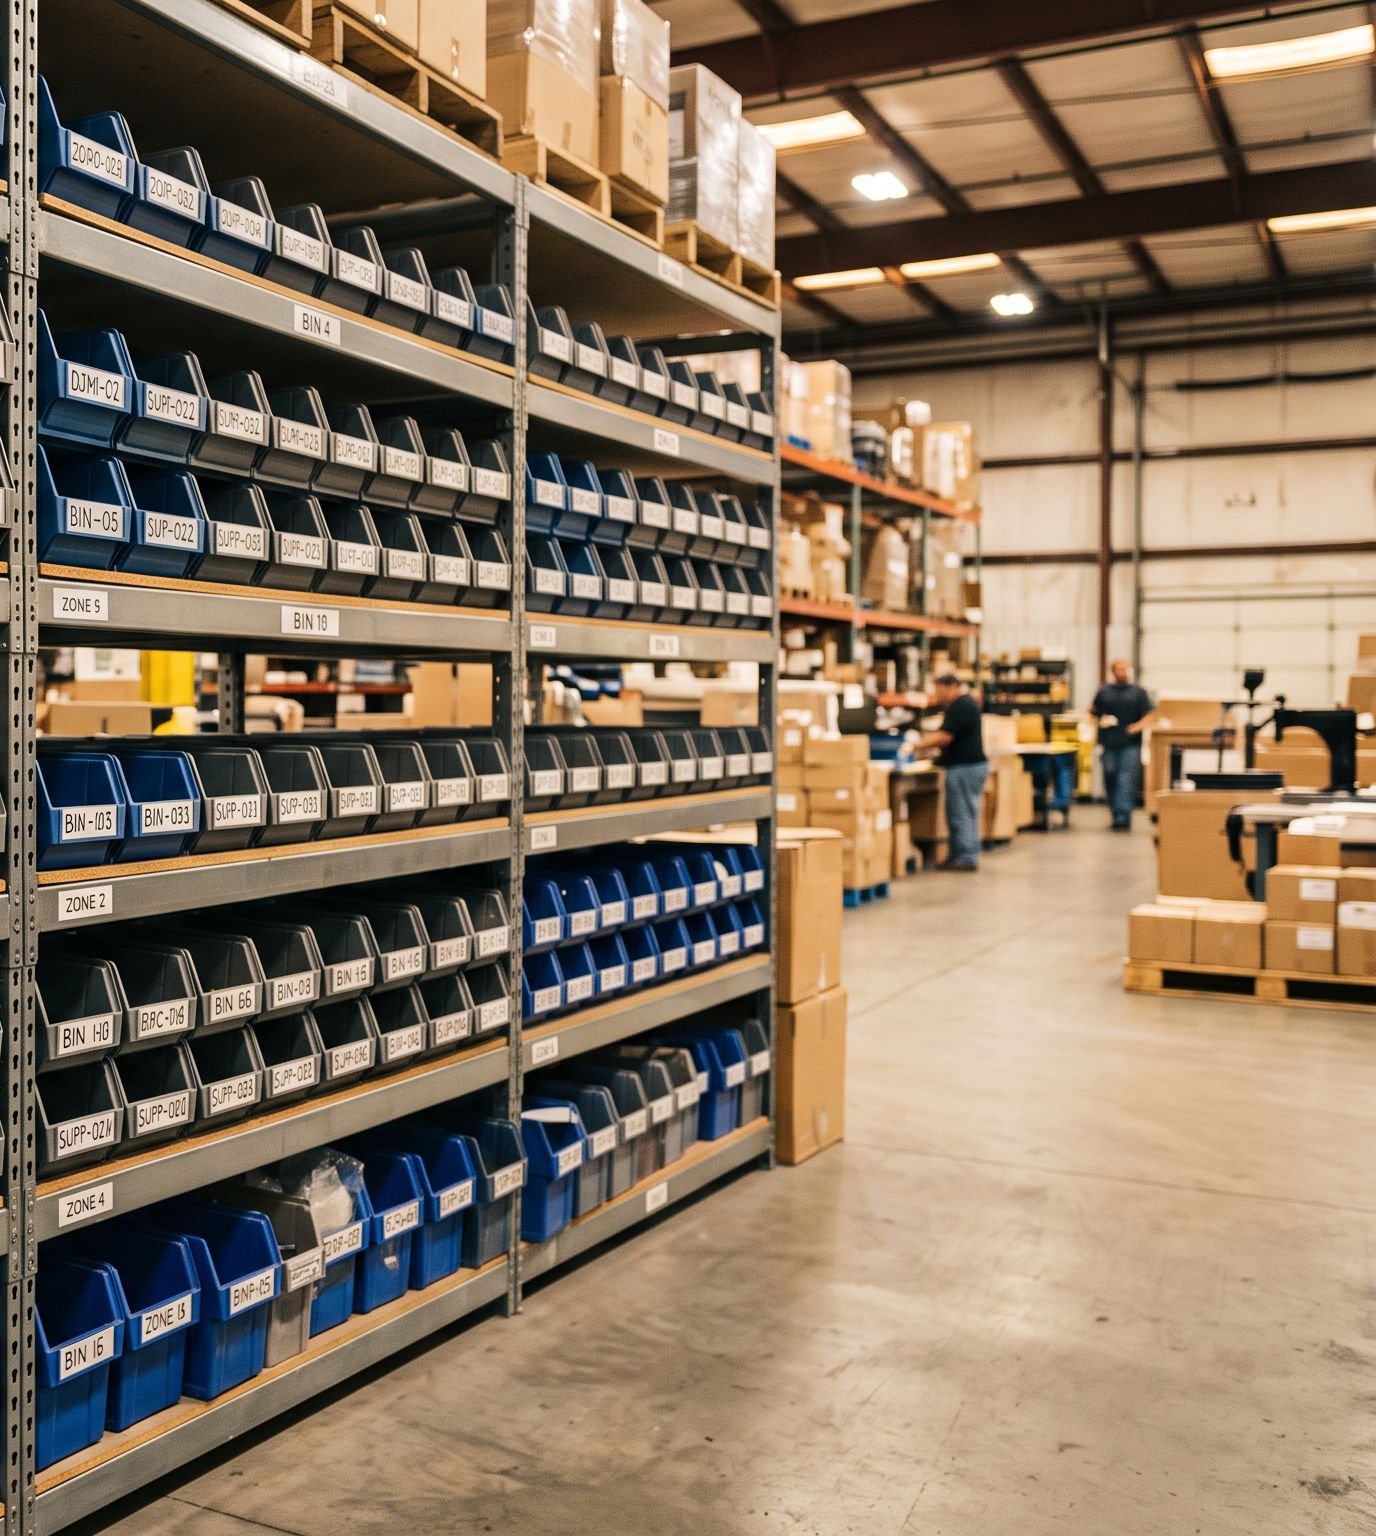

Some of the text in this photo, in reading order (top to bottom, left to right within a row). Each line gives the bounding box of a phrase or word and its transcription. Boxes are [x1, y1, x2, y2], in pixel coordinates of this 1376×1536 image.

[301, 312, 331, 338] BIN 4
[70, 504, 119, 533] BIN-05
[147, 516, 194, 544] SUP-022
[62, 596, 92, 613] ZONE
[293, 611, 314, 631] BIN
[144, 805, 190, 828] BIN-033
[65, 892, 106, 914] ZONE 2
[215, 994, 234, 1016] BIN
[63, 1025, 86, 1049] BIN
[66, 1191, 105, 1218] ZONE 4
[144, 1307, 174, 1335] ZONE
[64, 1344, 87, 1372] BIN
